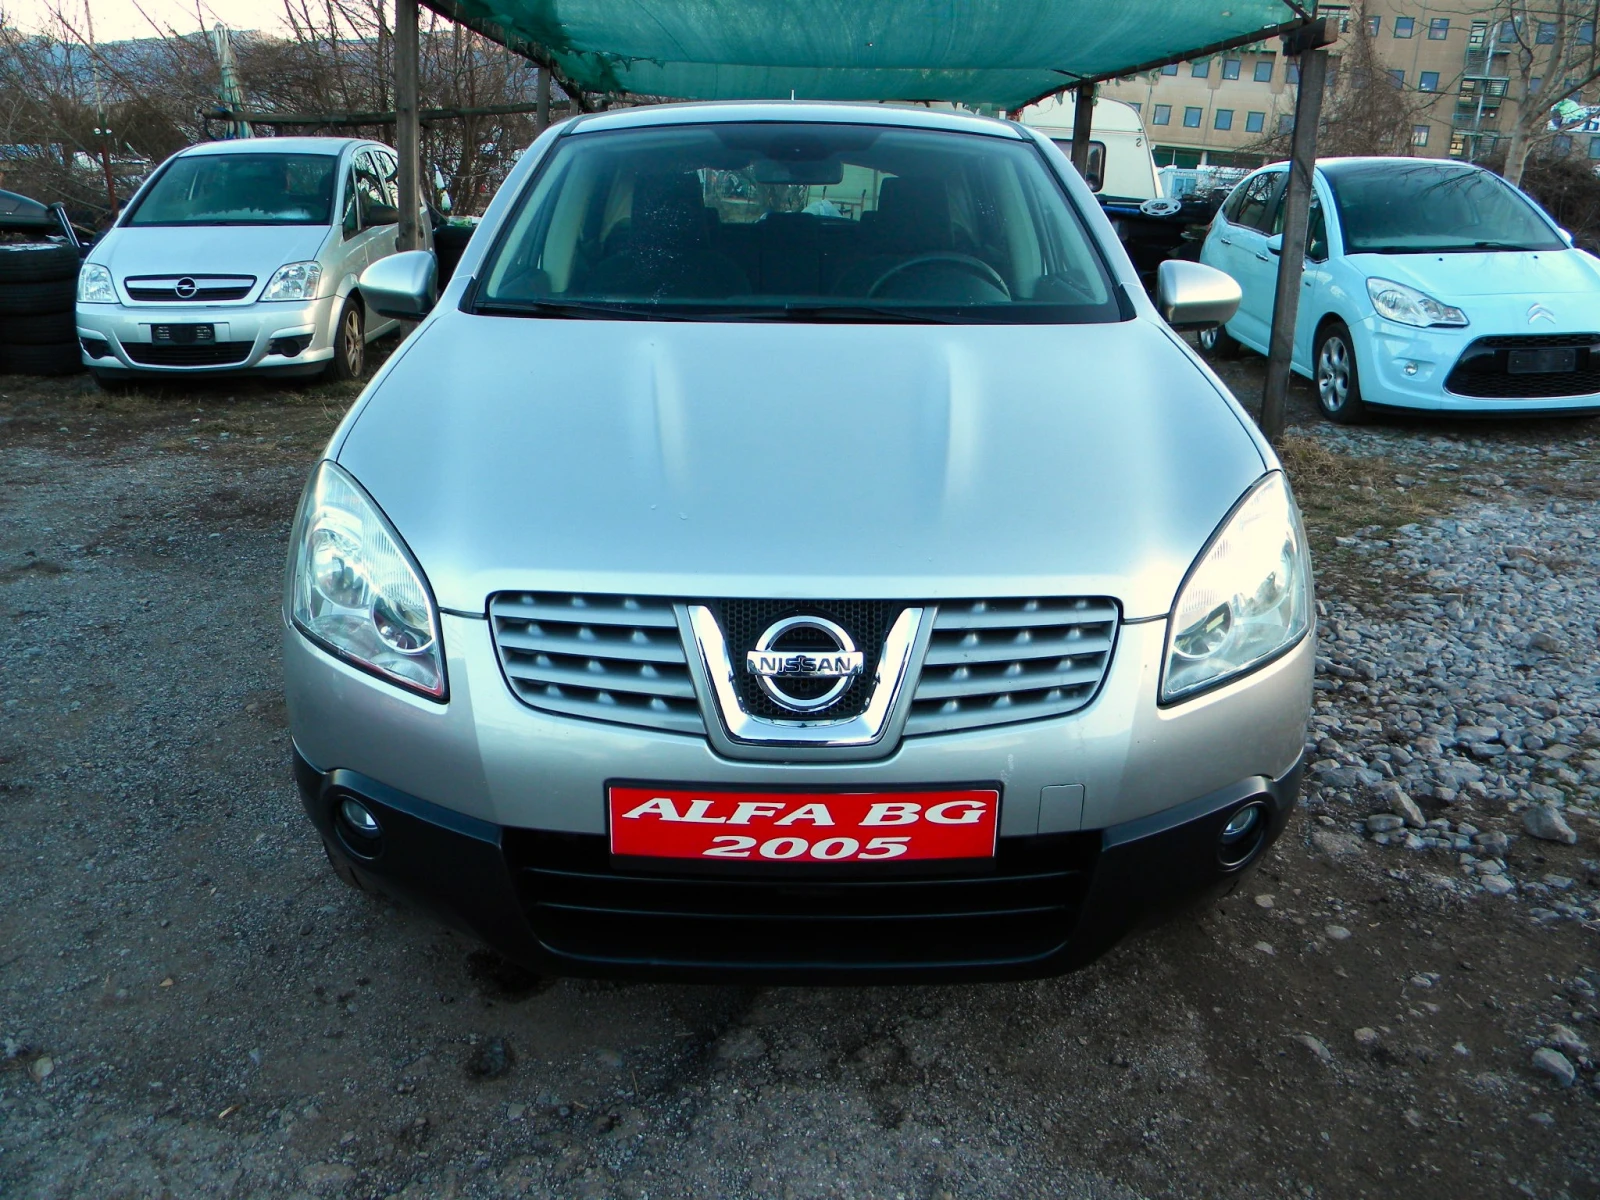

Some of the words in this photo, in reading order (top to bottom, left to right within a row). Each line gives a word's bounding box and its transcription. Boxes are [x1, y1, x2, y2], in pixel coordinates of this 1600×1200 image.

[759, 656, 851, 672] NISSAN
[621, 797, 836, 826] ALFA
[858, 800, 987, 826] BG
[702, 835, 911, 860] 2005
